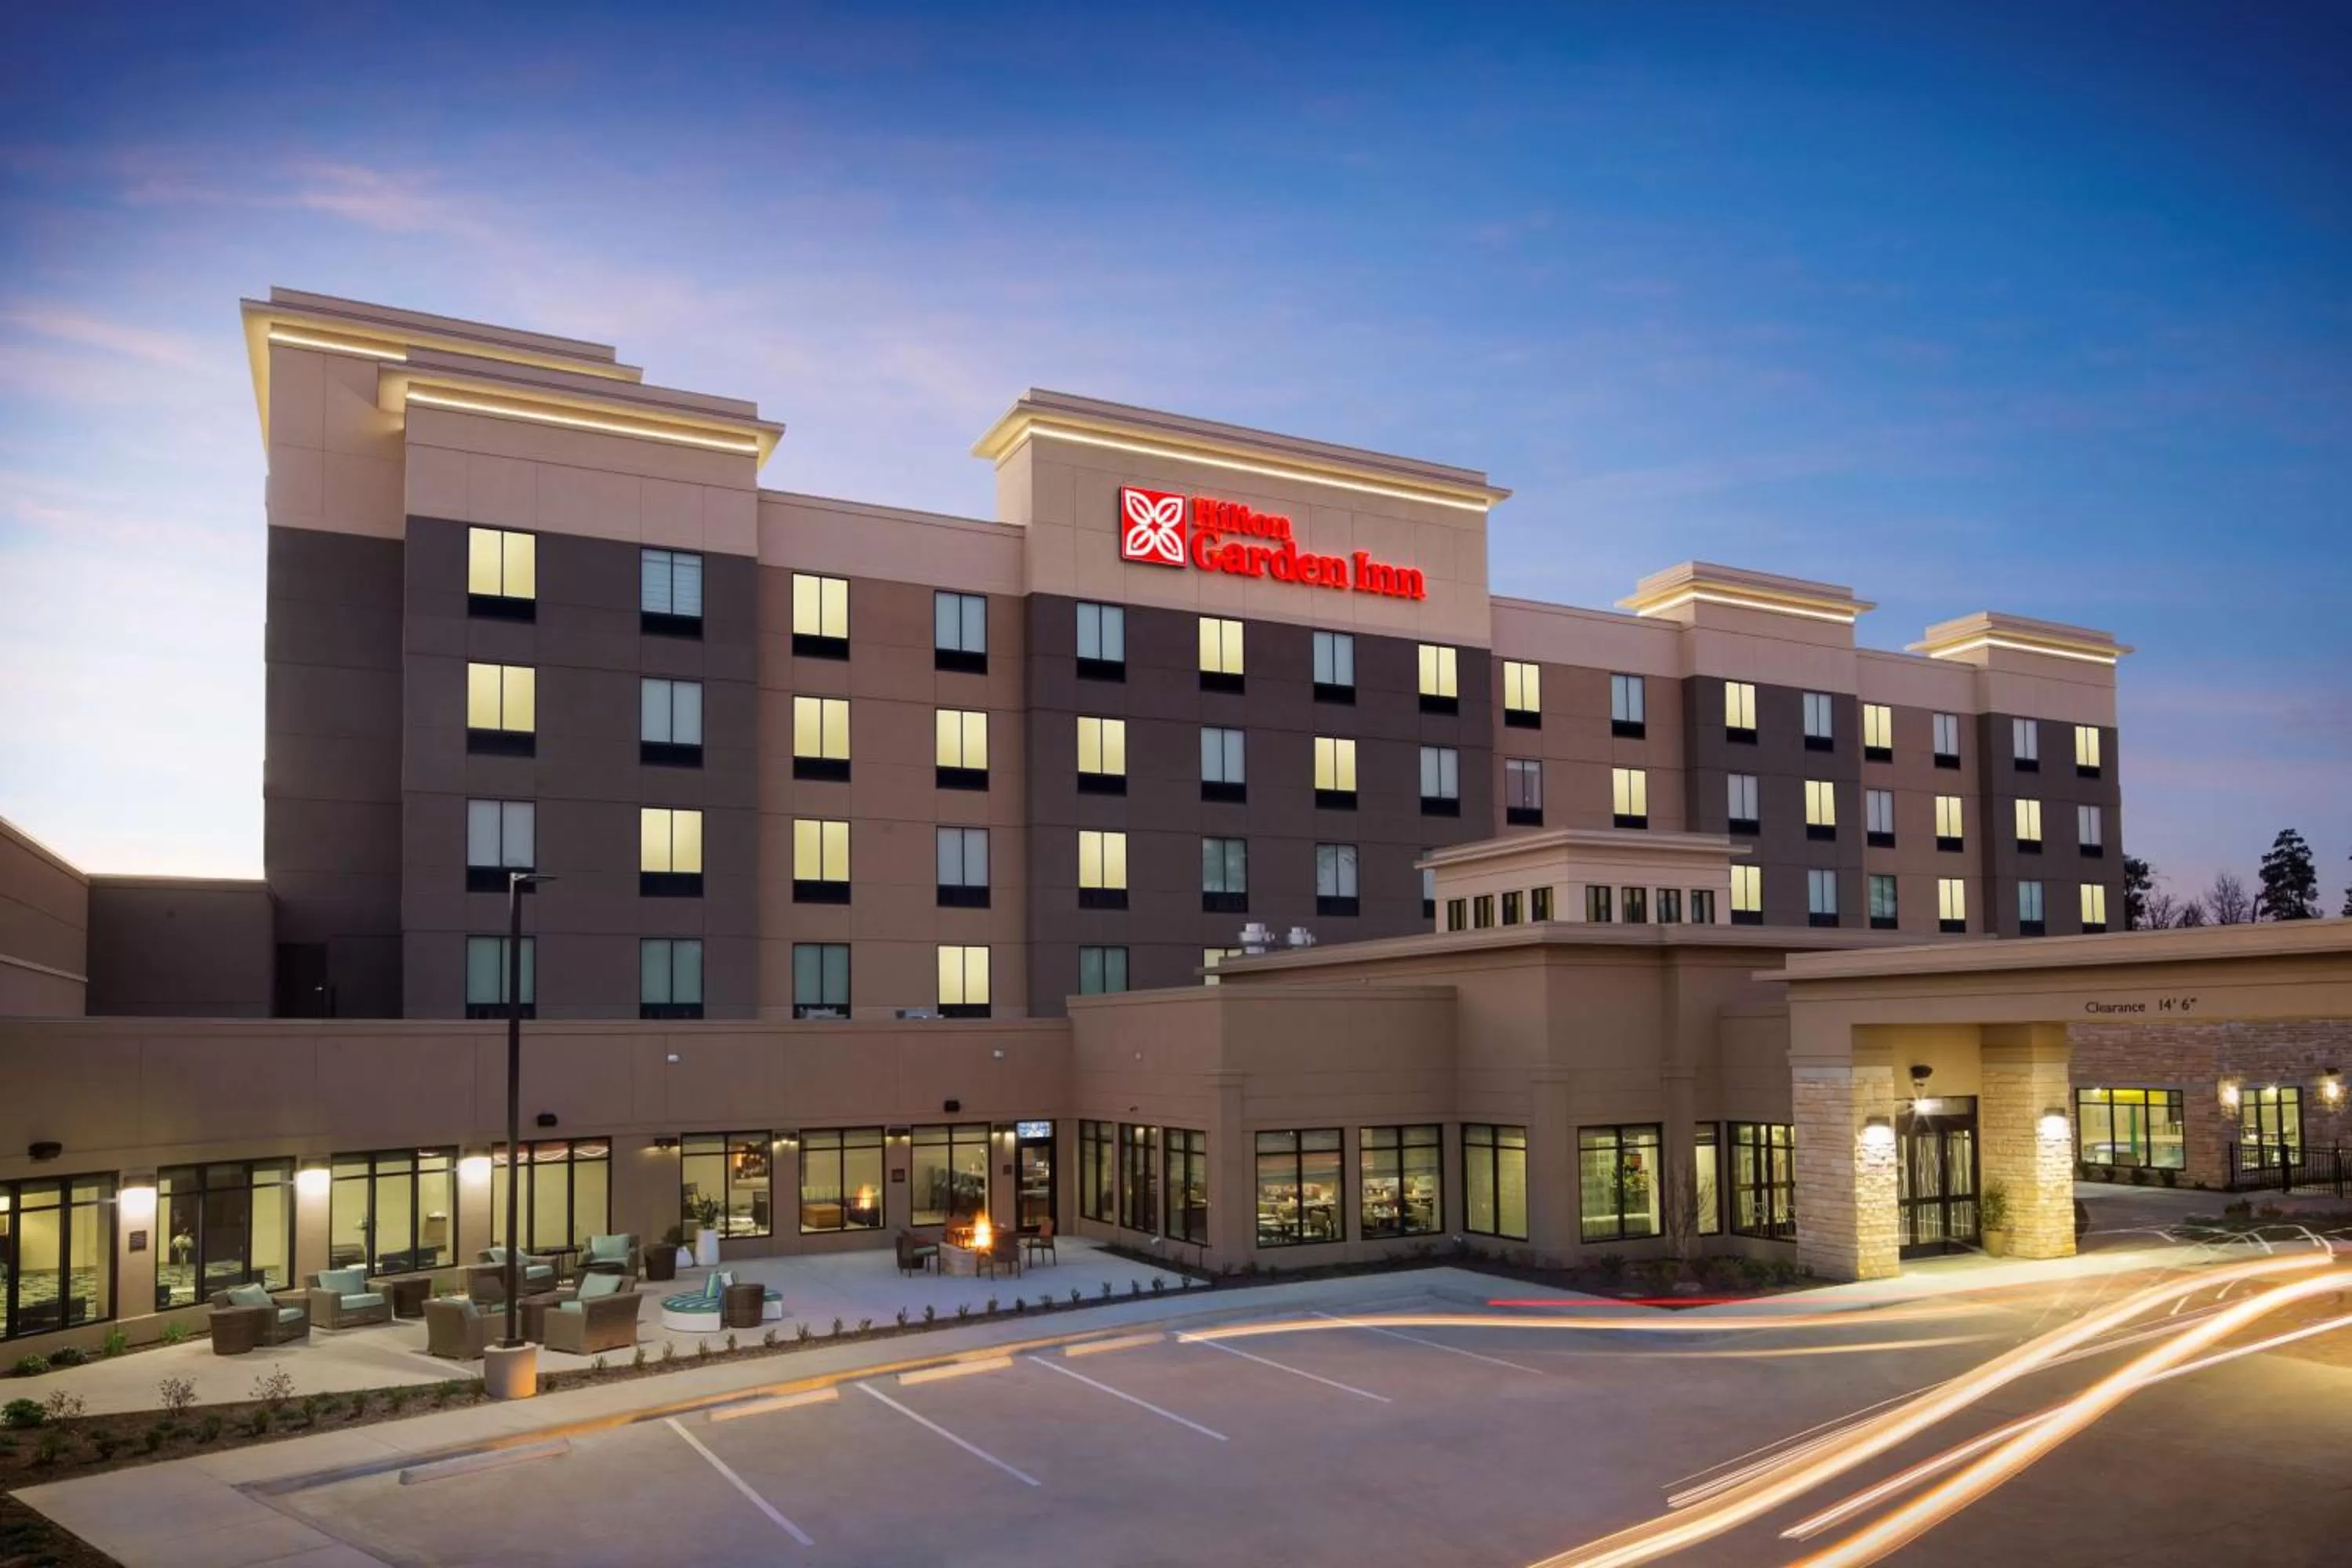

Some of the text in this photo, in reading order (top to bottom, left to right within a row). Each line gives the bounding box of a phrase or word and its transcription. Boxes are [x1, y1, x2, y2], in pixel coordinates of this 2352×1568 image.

[1192, 495, 1291, 540] Hilton
[1191, 530, 1425, 600] Garden Inn
[2085, 1001, 2146, 1014] Clearance
